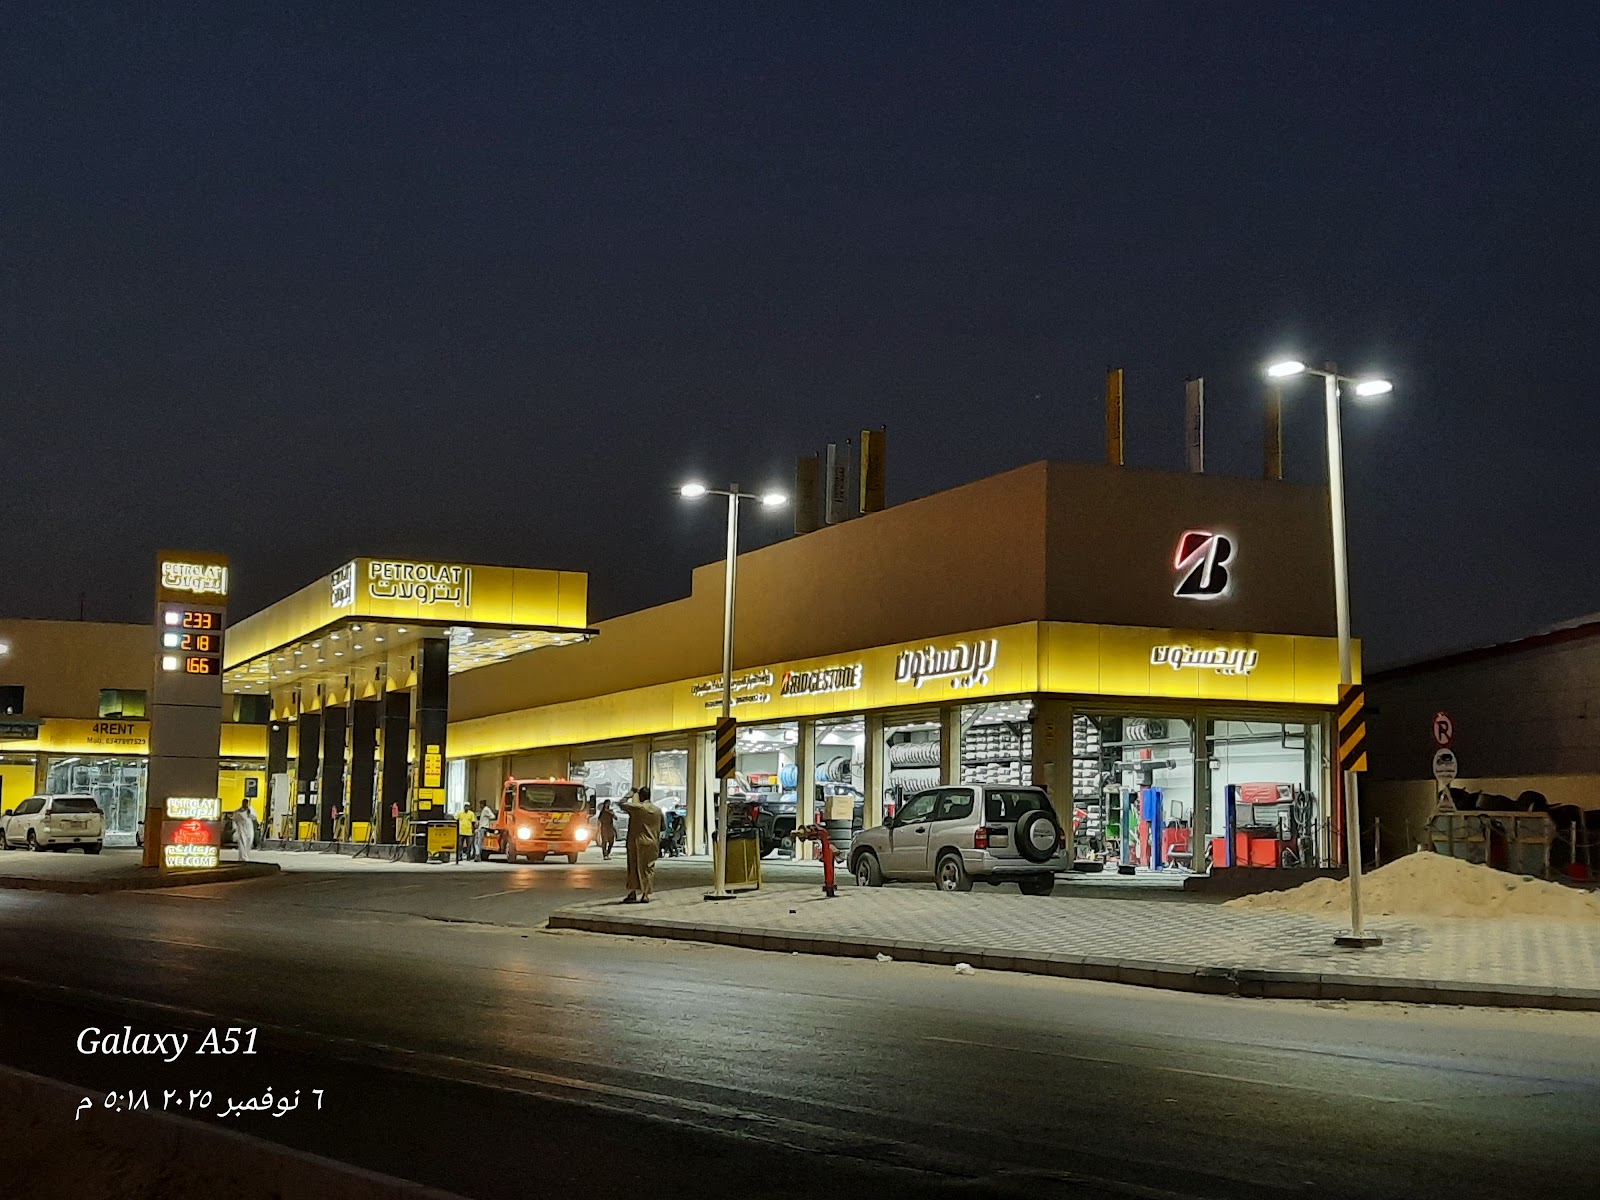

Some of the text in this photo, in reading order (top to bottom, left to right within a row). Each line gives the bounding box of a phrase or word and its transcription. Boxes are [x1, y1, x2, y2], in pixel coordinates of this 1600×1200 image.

[163, 563, 222, 578] PETROLAT
[370, 562, 463, 584] PETROLAT
[370, 581, 462, 606] بترولات
[895, 638, 998, 688] بريجستون
[1151, 645, 1259, 675] بريجستون
[781, 664, 862, 696] BRIDGESTONE
[92, 723, 135, 735] 4RENT
[166, 856, 217, 867] WELCOME
